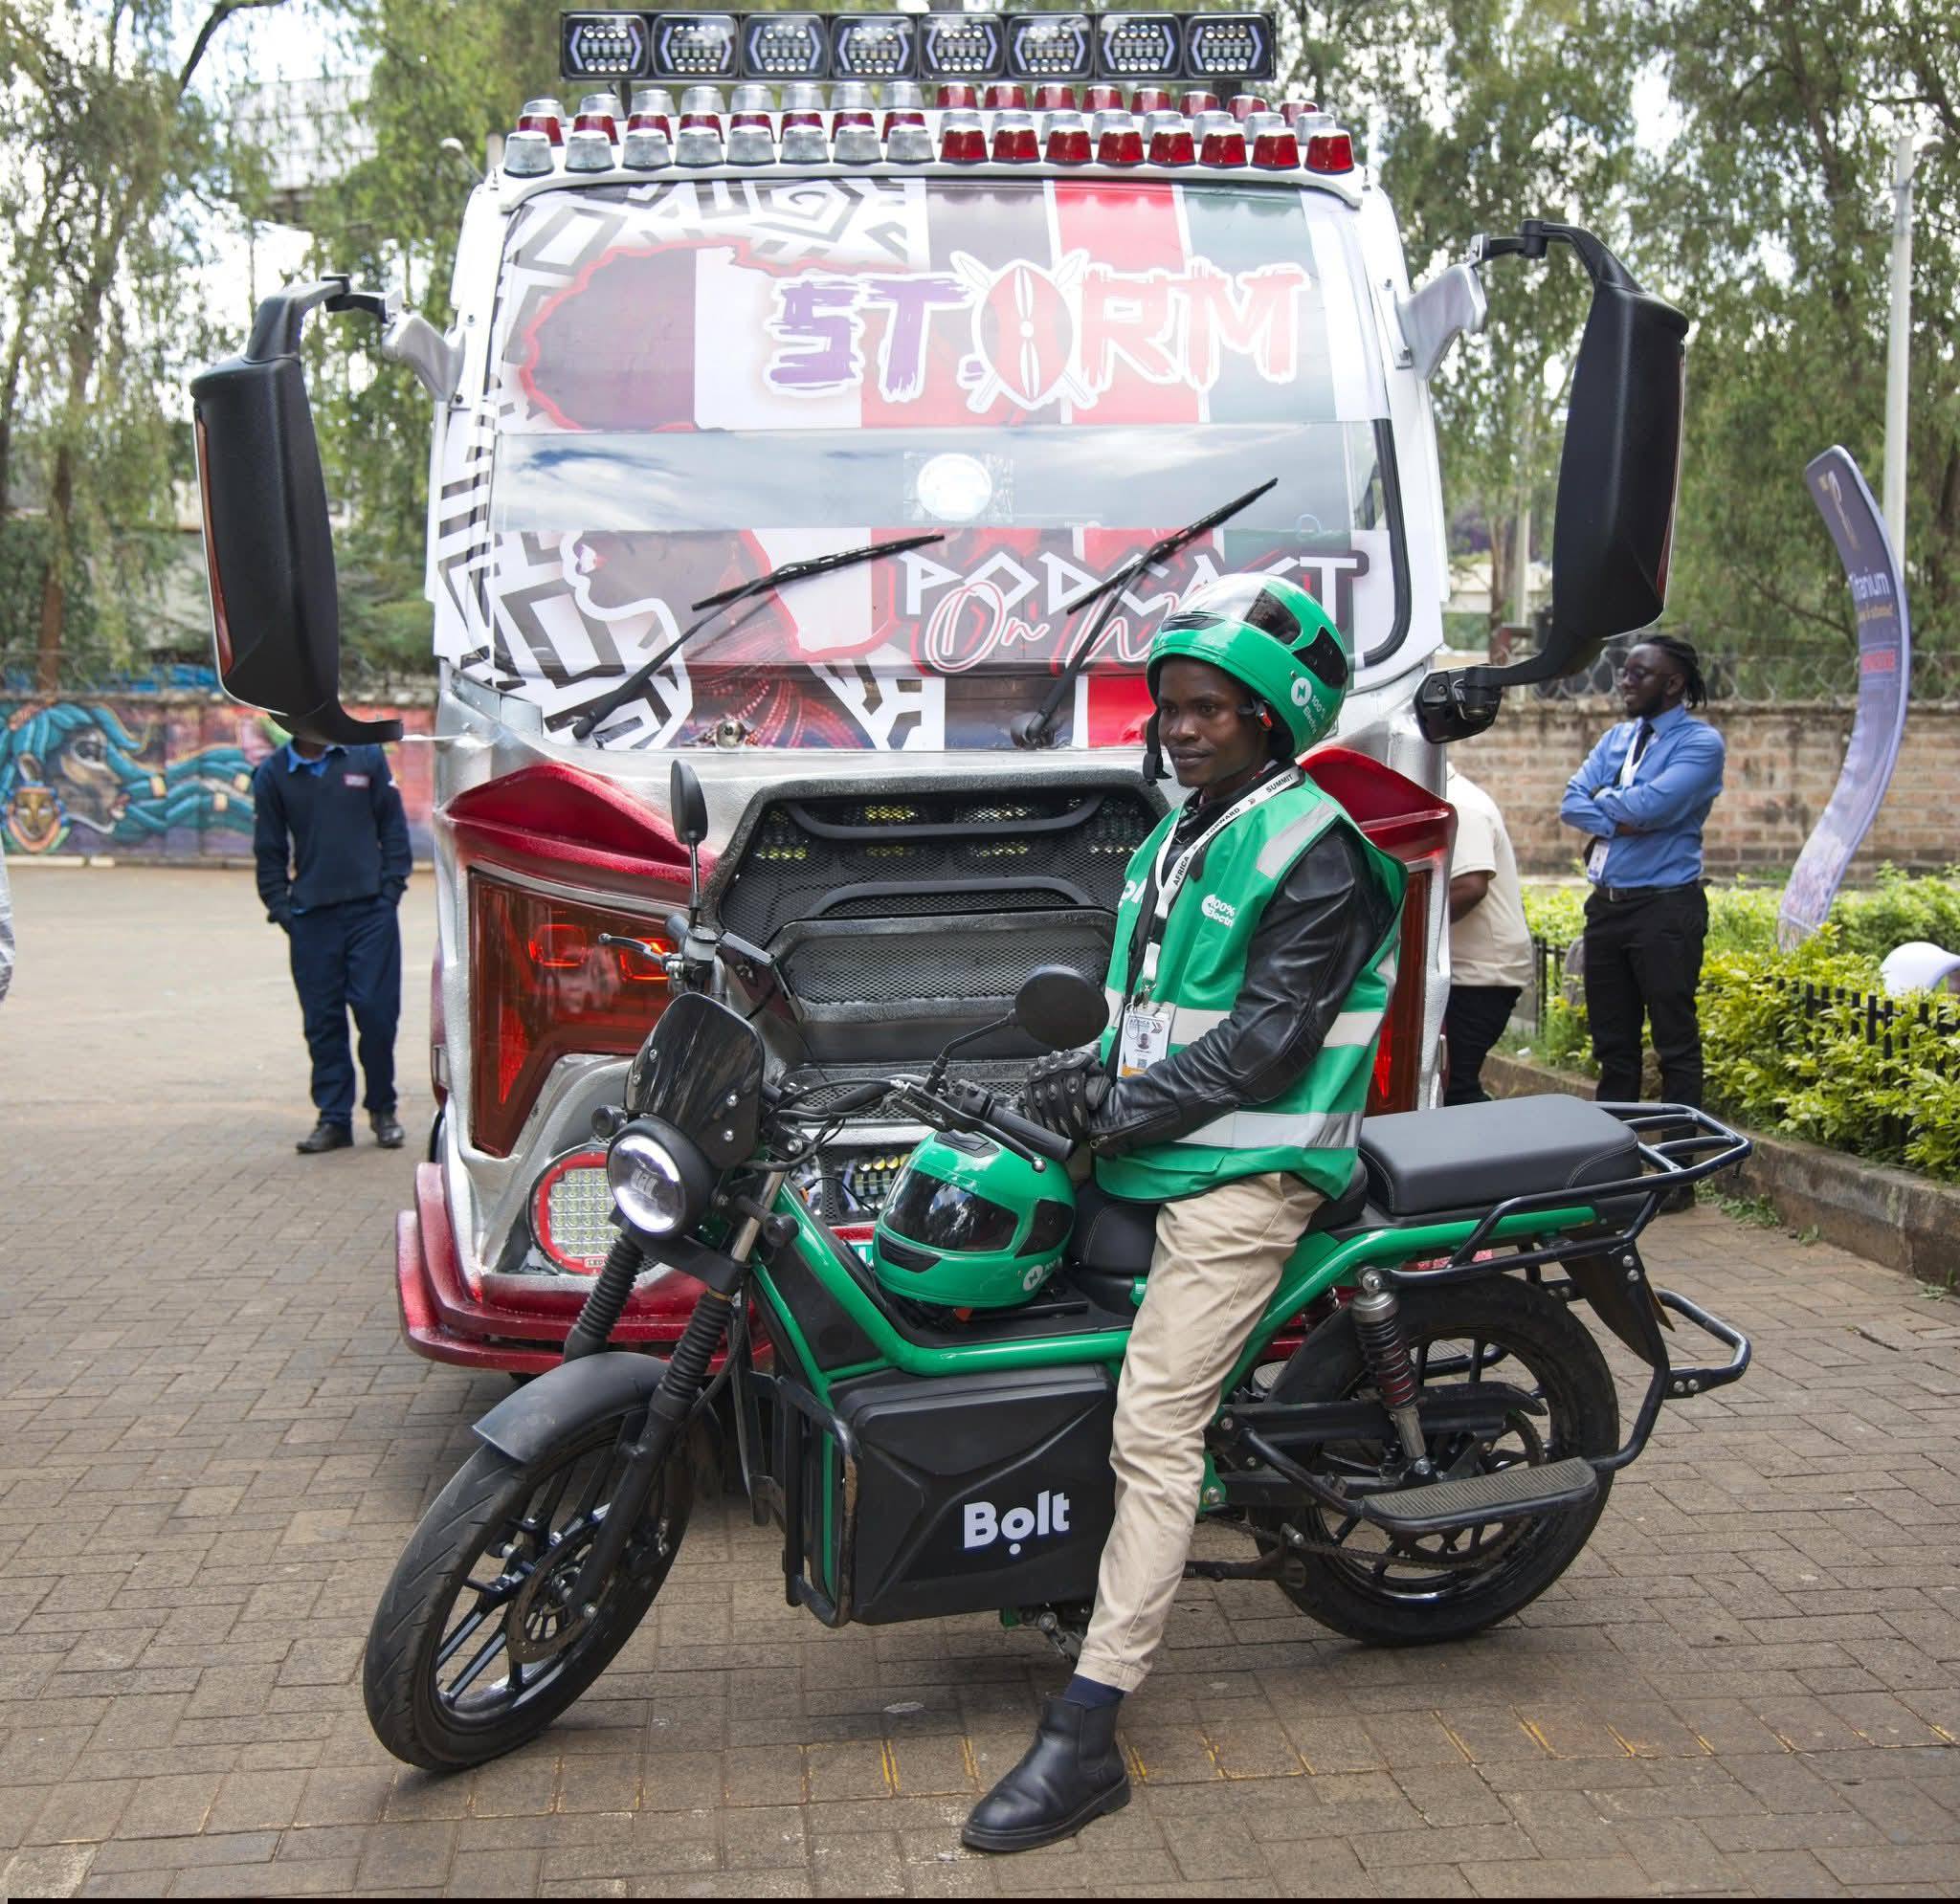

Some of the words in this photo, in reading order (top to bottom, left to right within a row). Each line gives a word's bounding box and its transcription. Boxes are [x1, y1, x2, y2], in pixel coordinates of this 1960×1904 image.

[1172, 855, 1191, 887] AFRICA
[1206, 808, 1240, 837] FORWARD
[1265, 773, 1294, 793] SUMMIT
[964, 1490, 1070, 1555] Bolt
